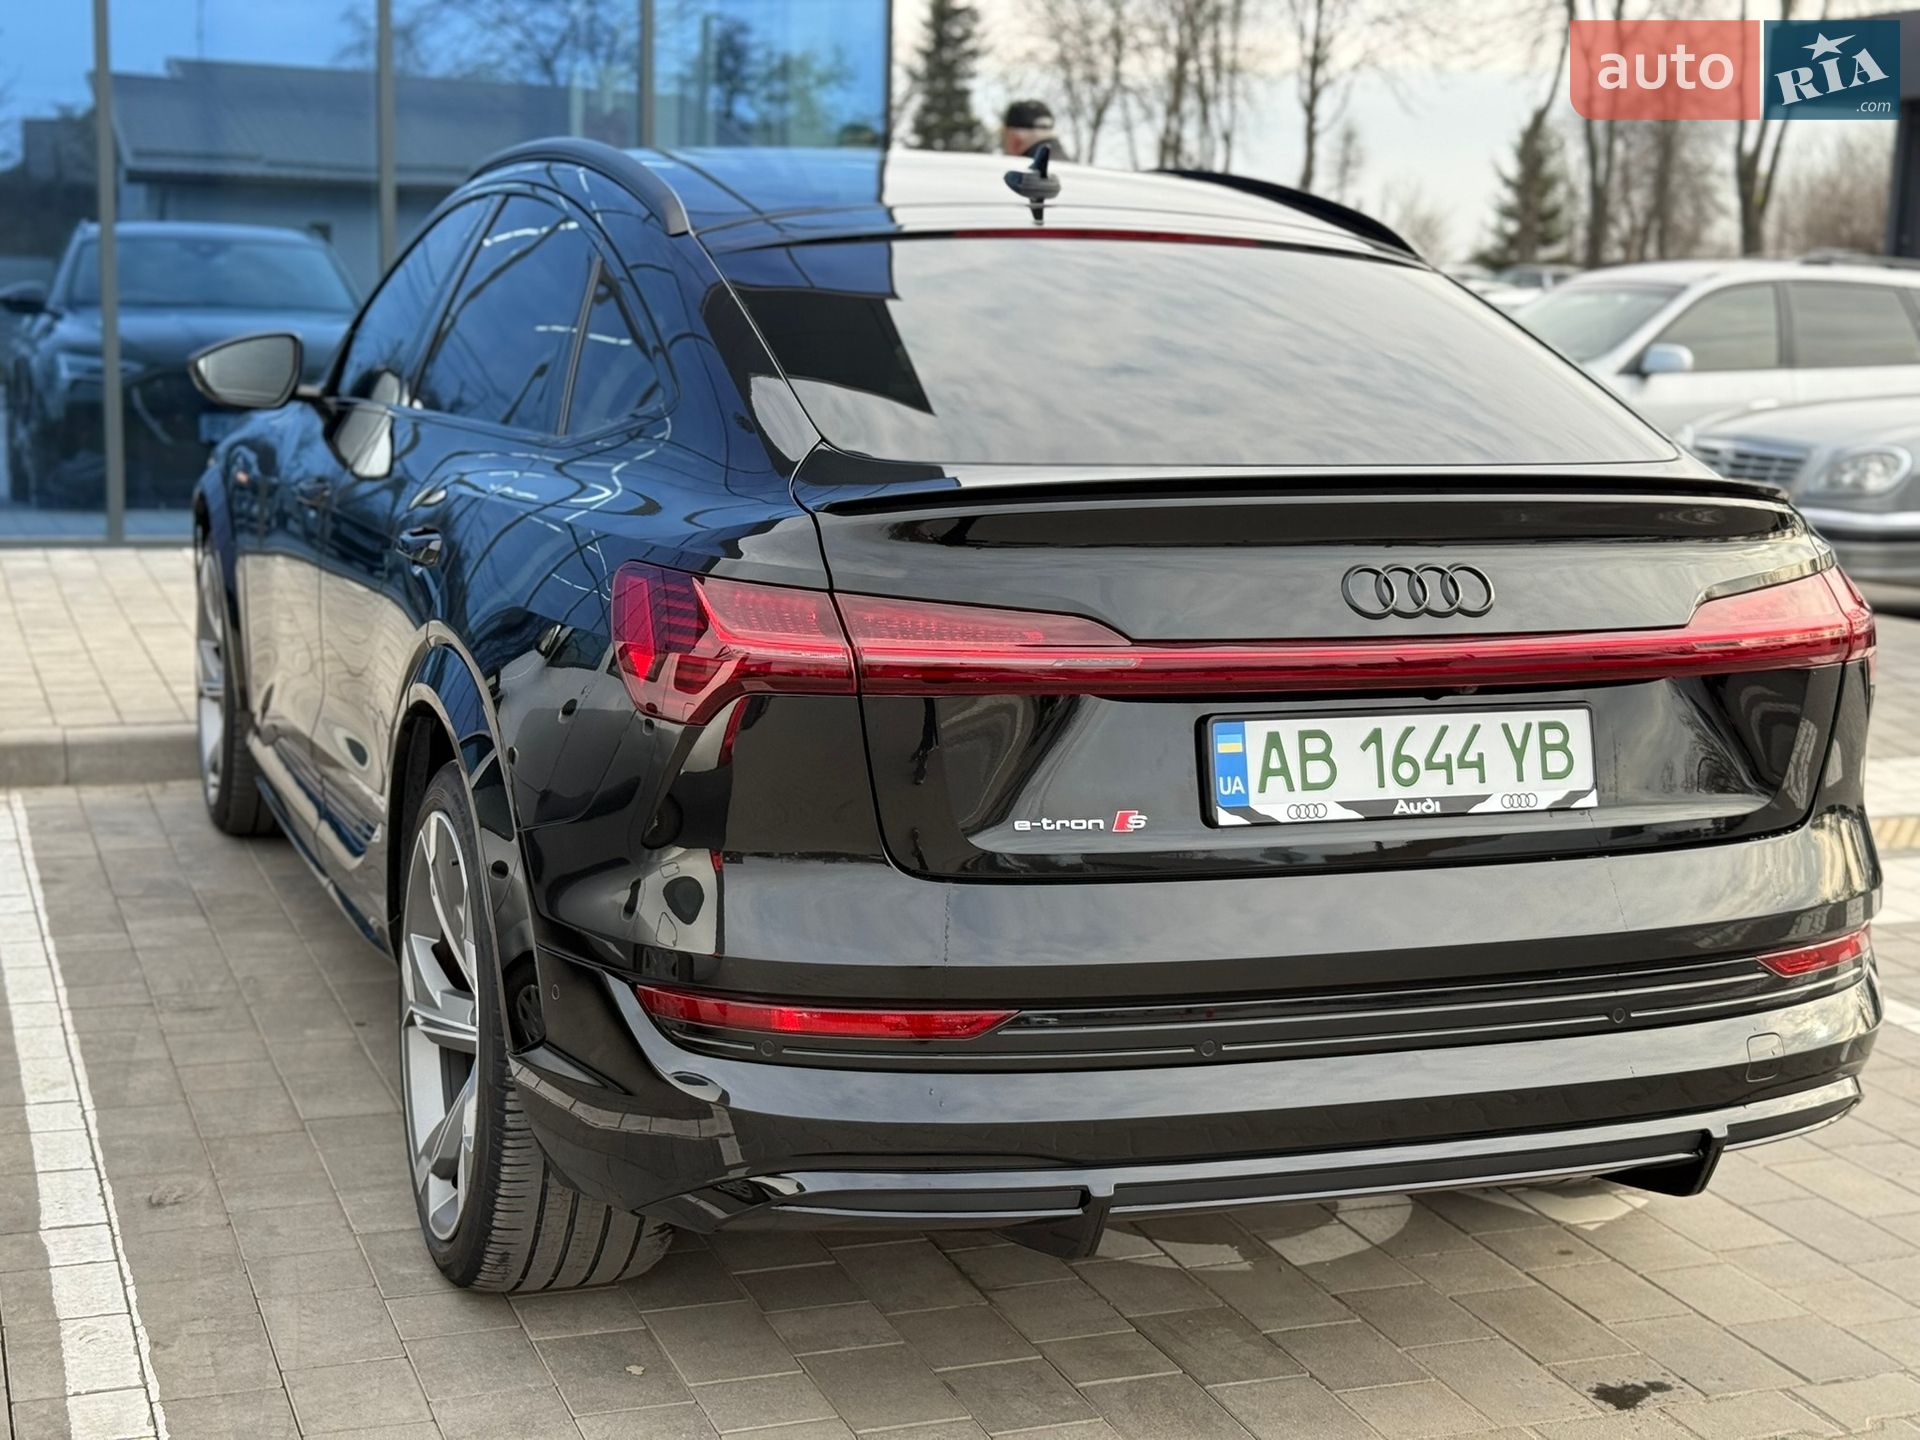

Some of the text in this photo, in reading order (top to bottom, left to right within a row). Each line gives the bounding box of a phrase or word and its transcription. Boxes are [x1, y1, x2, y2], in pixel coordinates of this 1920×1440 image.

[1257, 720, 1575, 794] AB 1644 YB
[1219, 777, 1246, 796] UA
[1392, 797, 1441, 815] Audi
[1014, 817, 1104, 831] e-tron
